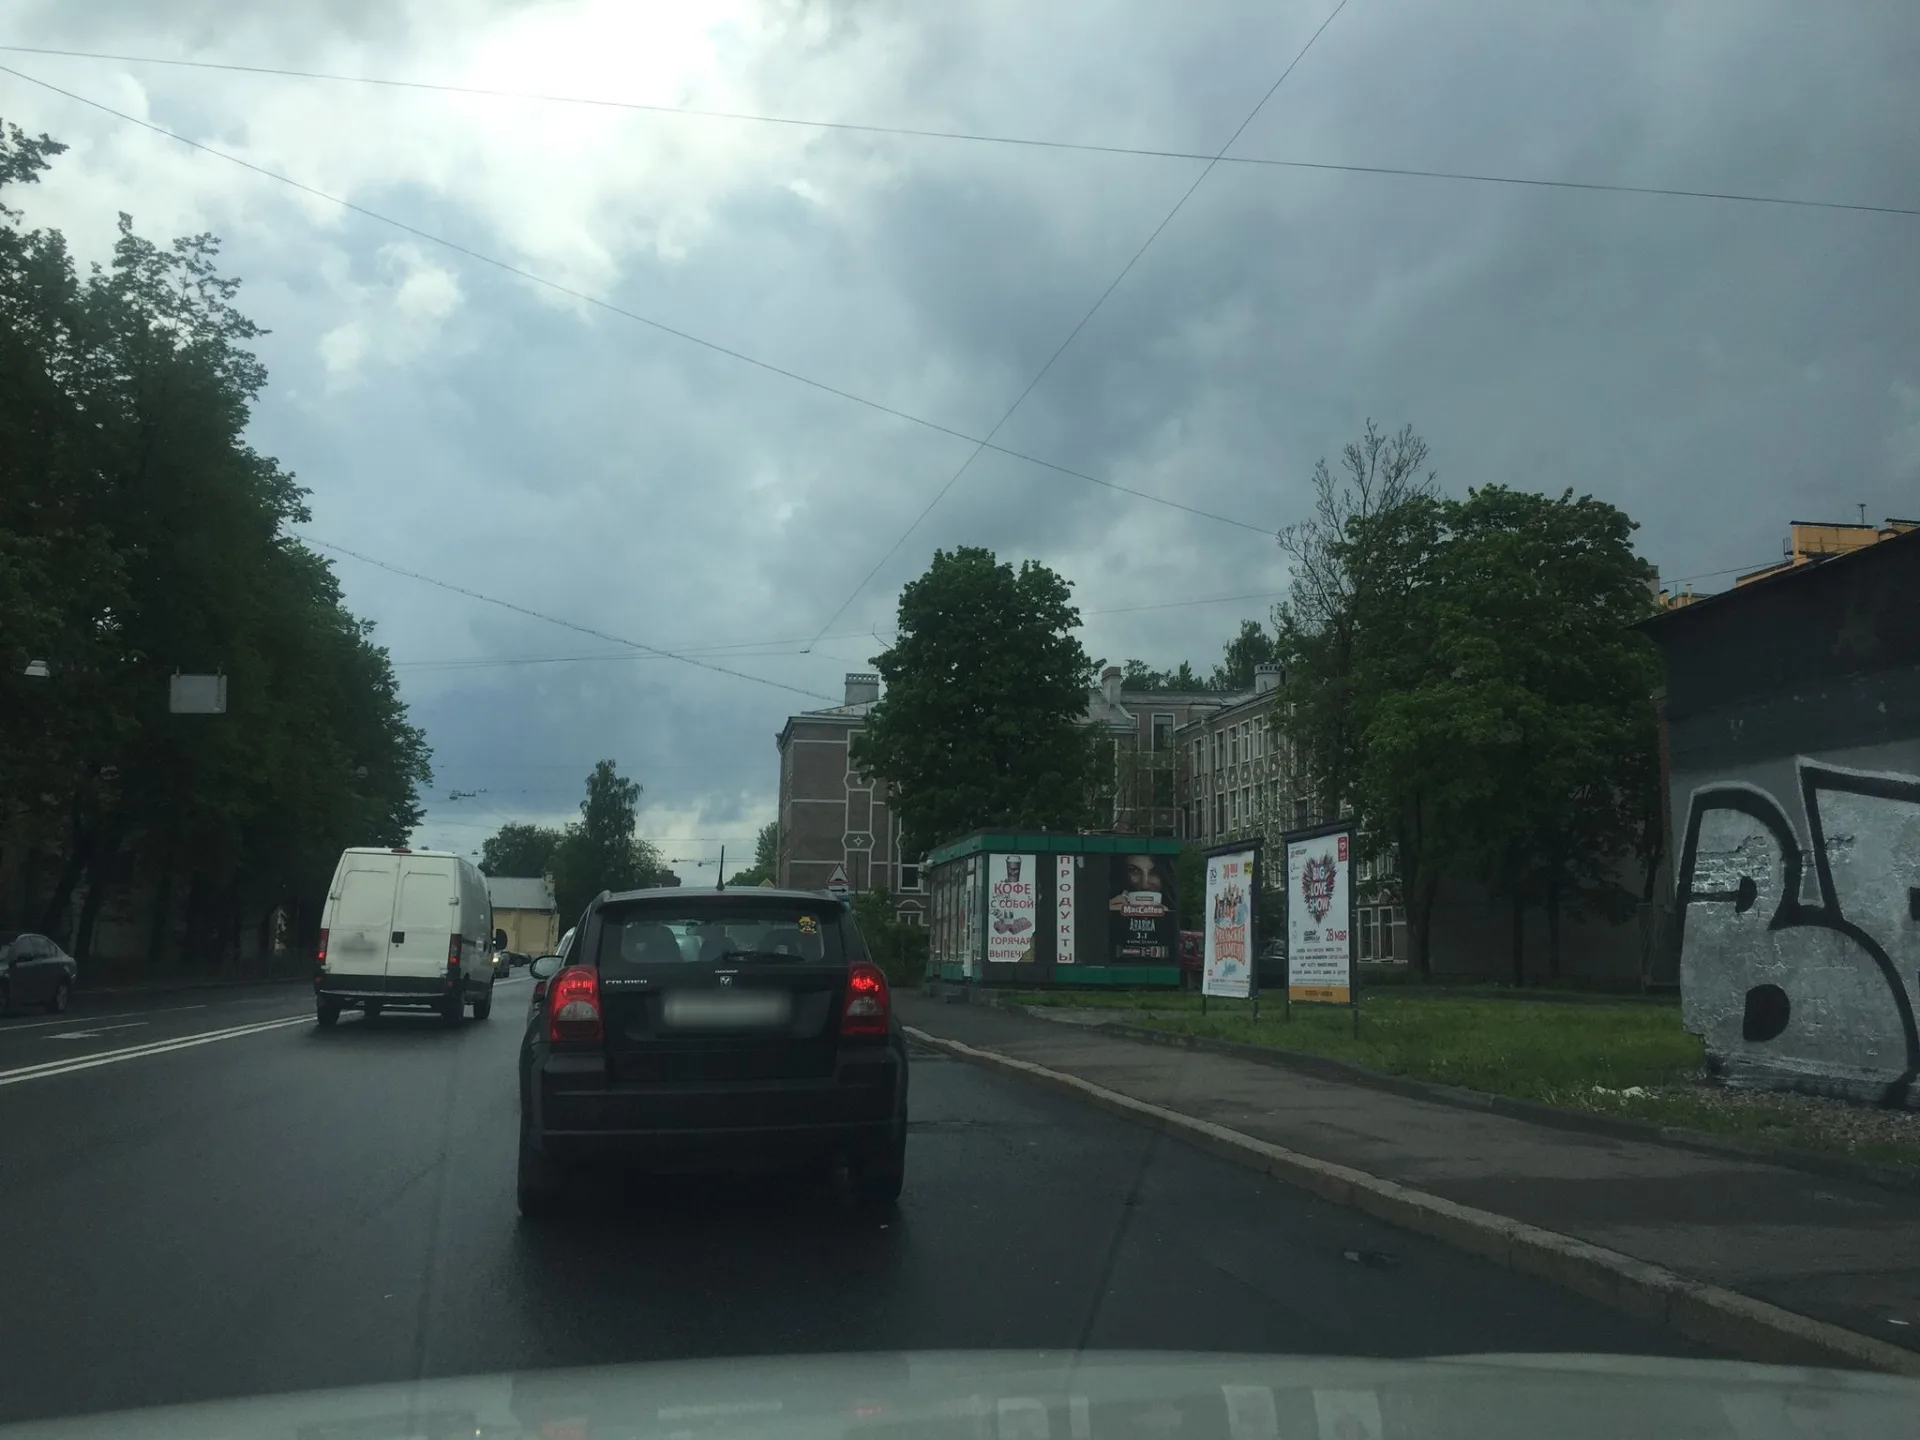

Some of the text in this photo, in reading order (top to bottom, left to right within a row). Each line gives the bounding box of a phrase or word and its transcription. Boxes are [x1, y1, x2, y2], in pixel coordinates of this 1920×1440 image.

[1313, 866, 1325, 881] BIG
[994, 883, 1032, 894] КОФЕ
[1310, 881, 1327, 896] LOVE
[990, 897, 1034, 908] С СОБОЙ
[1058, 856, 1073, 961] ПРОДУКТЫ
[1123, 905, 1163, 914] MacCoffee
[1309, 896, 1330, 912] SHOW
[1325, 928, 1334, 942] 28
